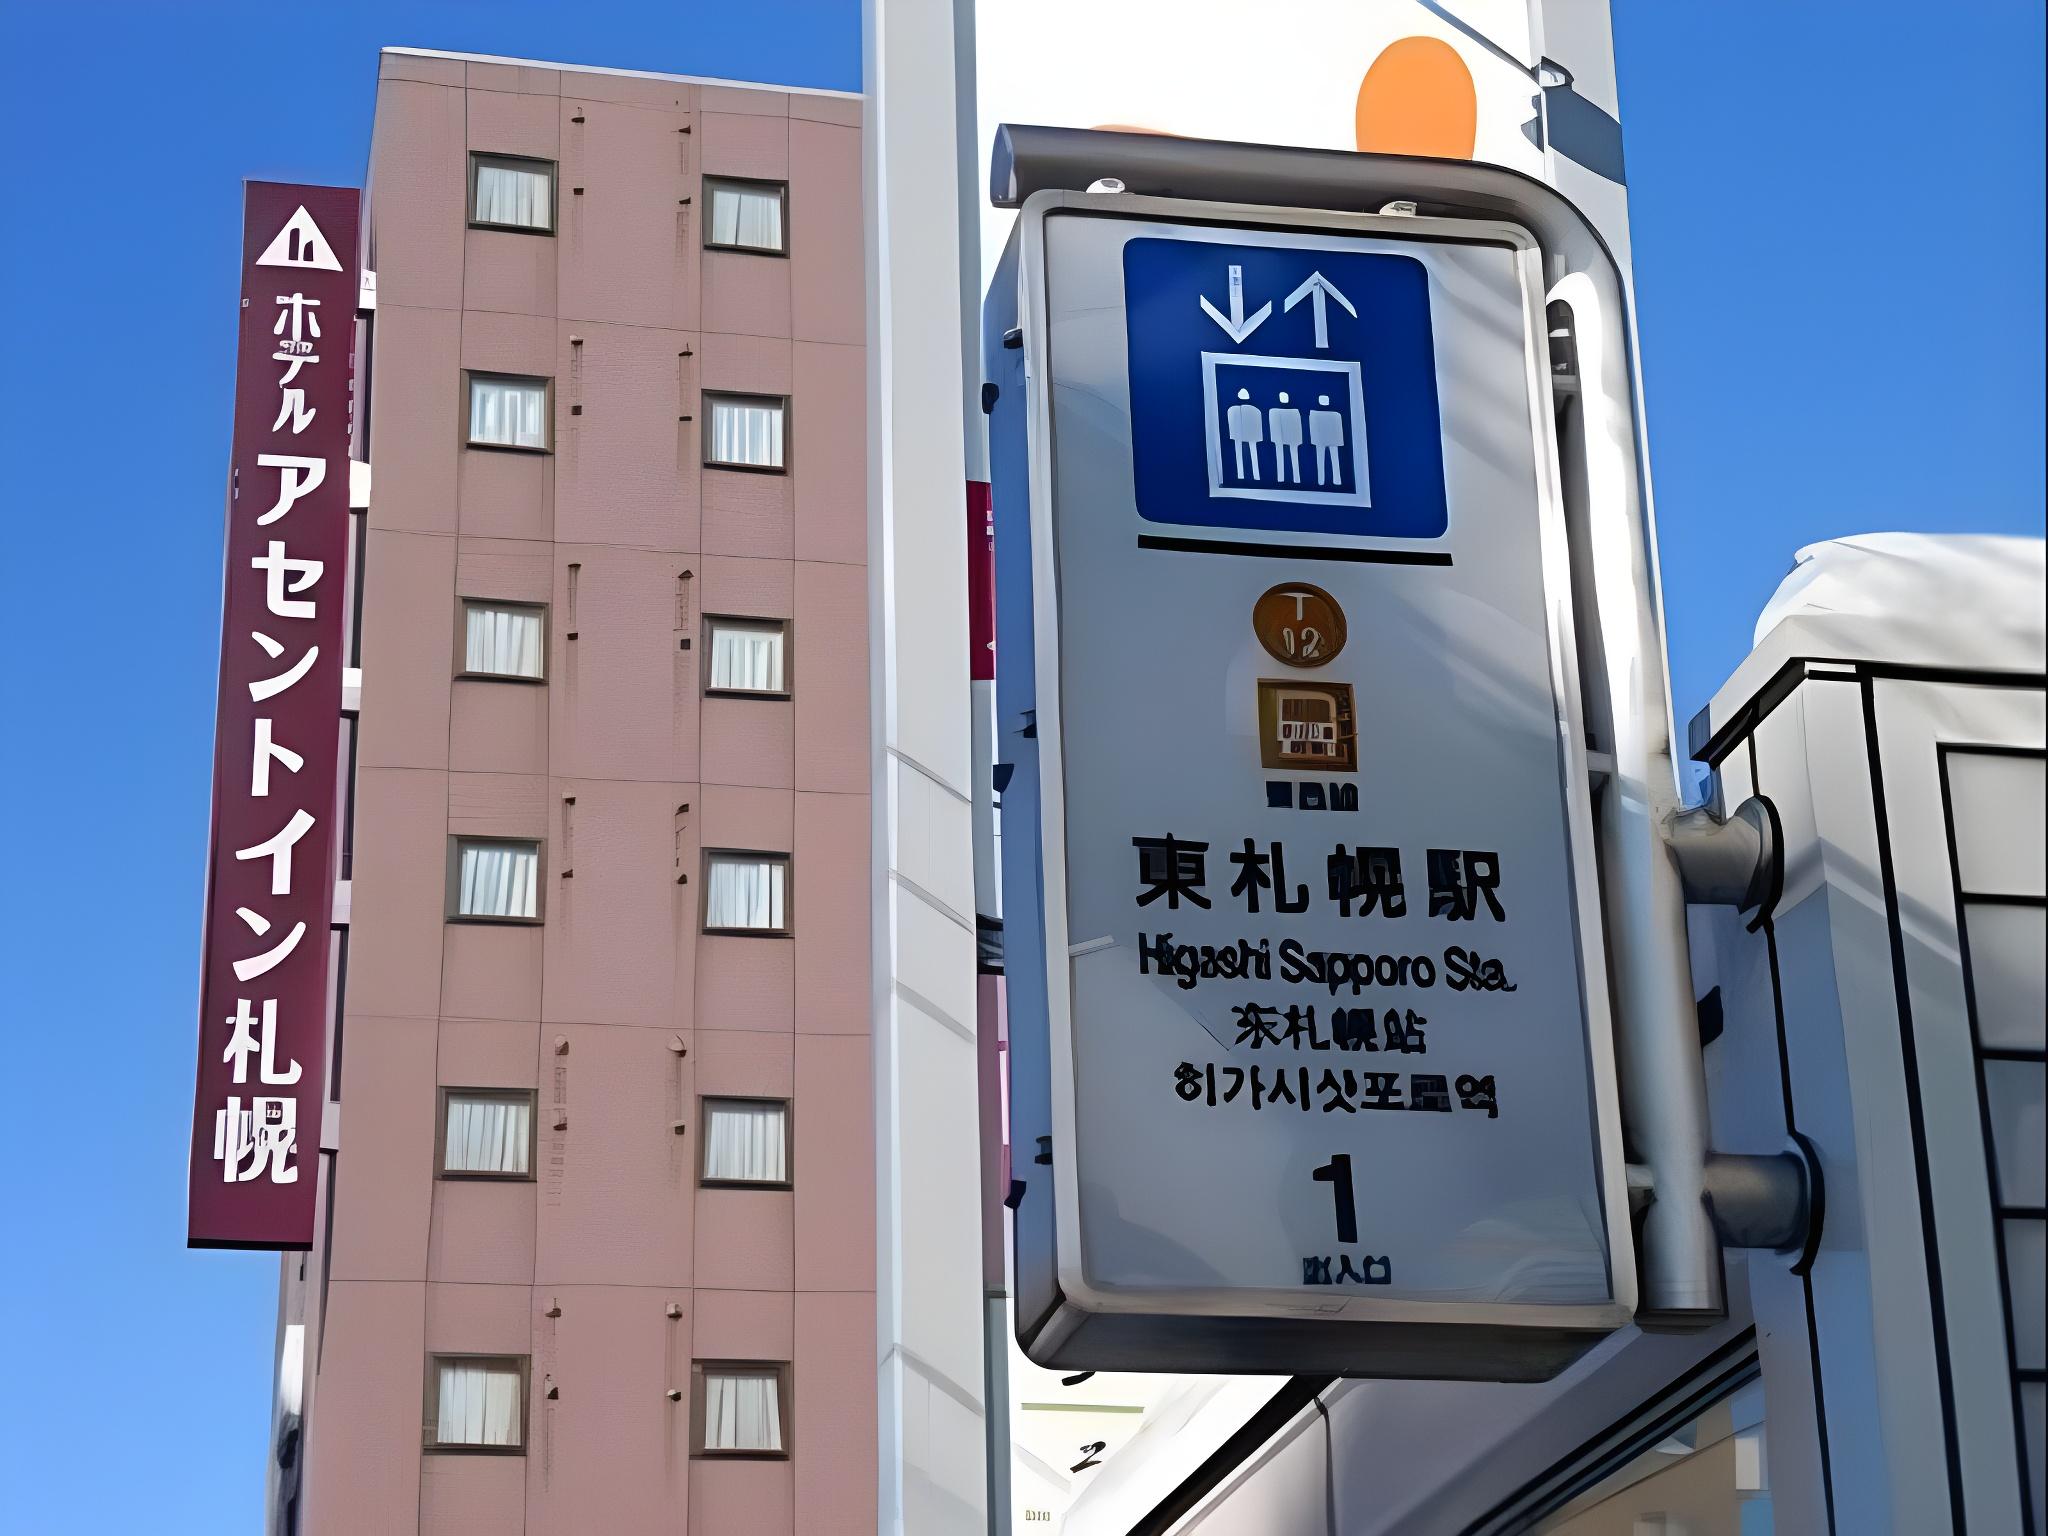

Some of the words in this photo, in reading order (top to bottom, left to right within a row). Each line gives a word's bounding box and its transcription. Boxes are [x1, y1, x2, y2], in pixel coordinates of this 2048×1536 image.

[1280, 592, 1315, 621] T
[1132, 832, 1506, 922] 東札幌駅
[1278, 938, 1436, 996] Sapporo
[1312, 1153, 1358, 1243] 1
